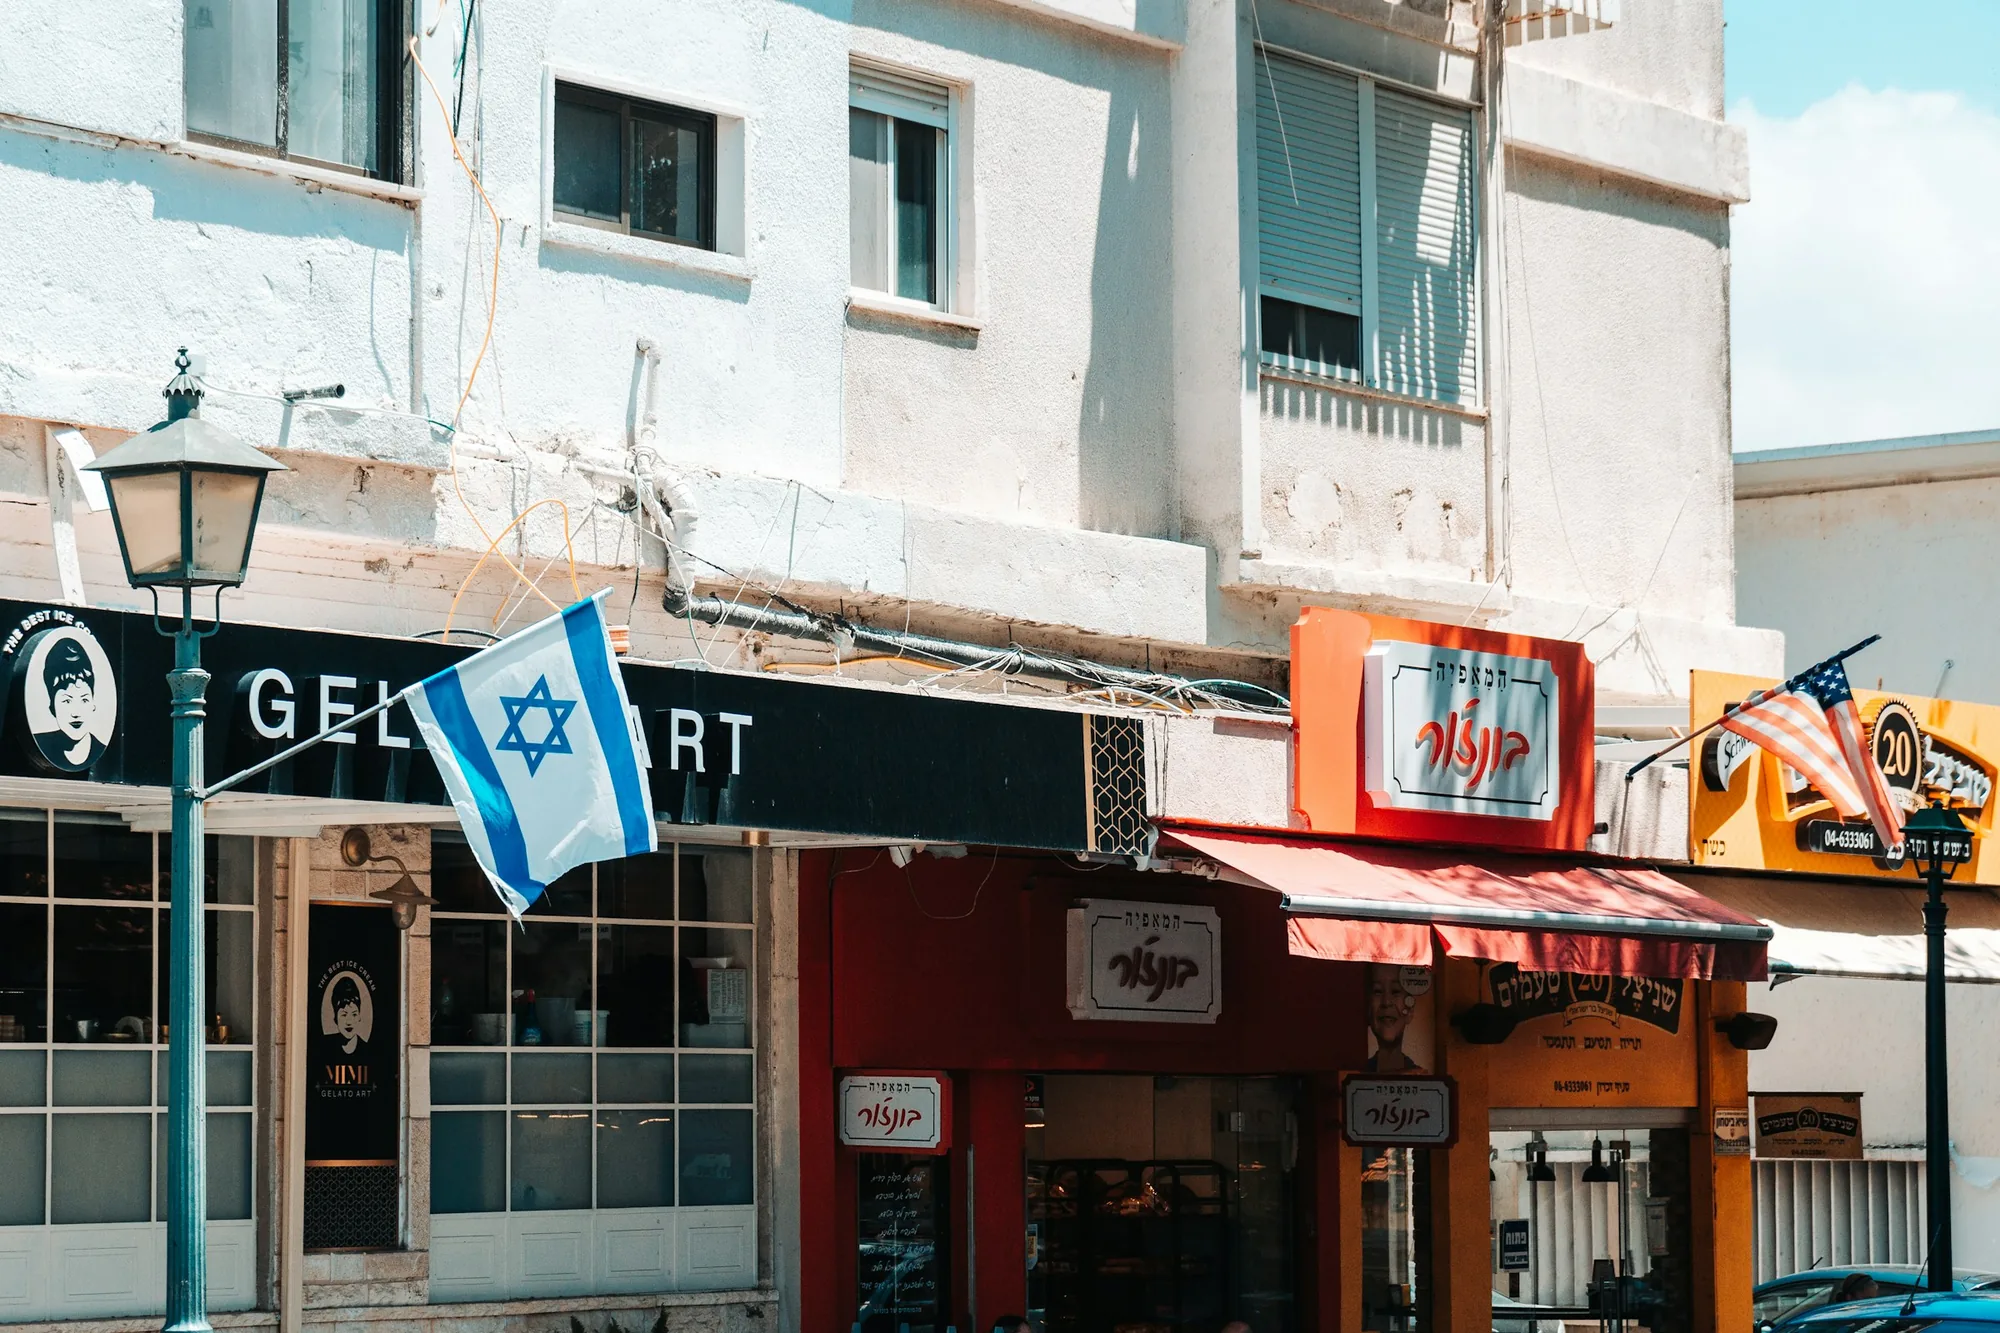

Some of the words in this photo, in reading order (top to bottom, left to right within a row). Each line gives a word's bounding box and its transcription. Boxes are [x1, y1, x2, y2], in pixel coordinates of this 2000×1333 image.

[3, 628, 24, 654] THE
[21, 610, 51, 631] BEST
[53, 610, 75, 624] ICE
[248, 667, 411, 749] GEL
[1882, 729, 1912, 777] 20
[1923, 734, 1992, 809] שניצל
[1702, 839, 1726, 856] כשר
[1824, 828, 1874, 850] 04-6333061
[317, 974, 329, 990] THE
[328, 961, 345, 975] BEST
[346, 960, 358, 970] ICE
[358, 965, 377, 992] CREAM
[1578, 973, 1604, 992] 20
[1497, 971, 1561, 1008] טעמים
[1621, 976, 1677, 1013] שניצל
[325, 1065, 368, 1085] MIMI
[321, 1089, 354, 1098] GELATO
[356, 1089, 372, 1098] ART
[1761, 1116, 1795, 1131] טעמים
[1802, 1113, 1815, 1125] 20
[1822, 1113, 1855, 1131] שניצל
[1505, 1231, 1527, 1245] פתוח
